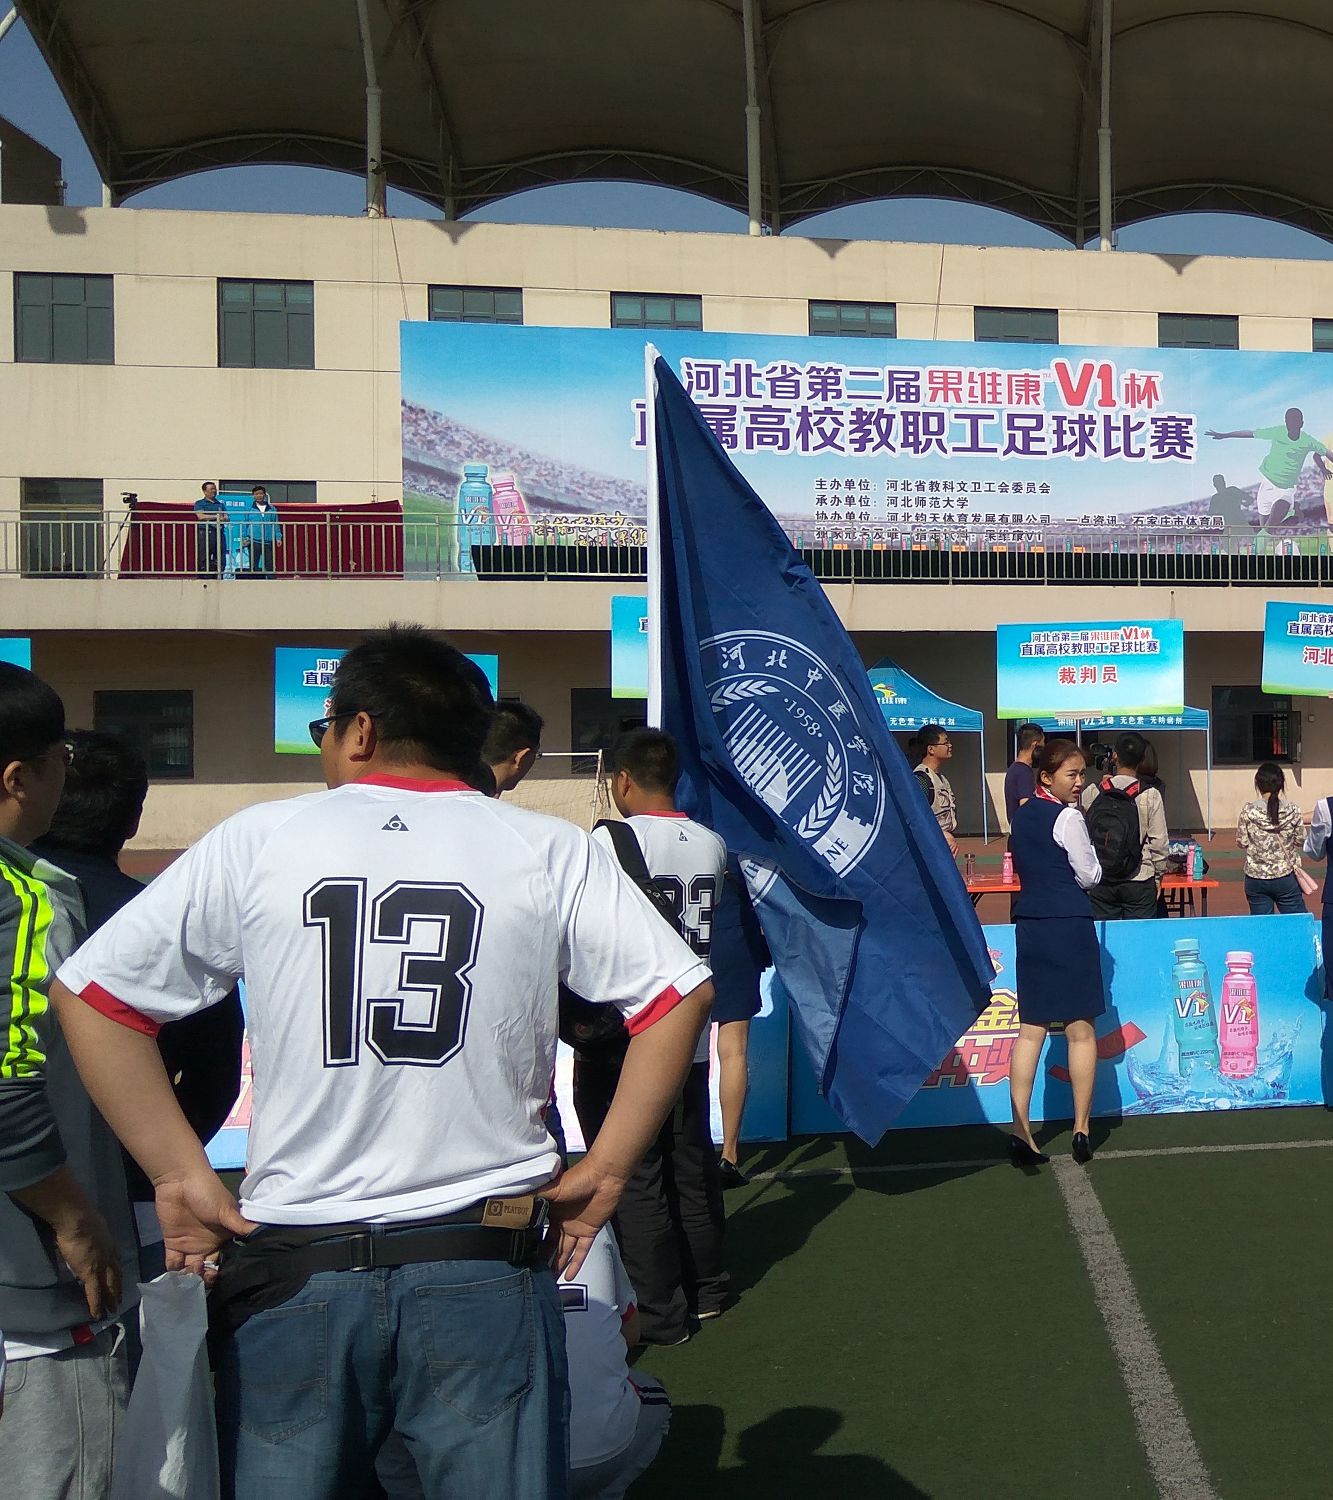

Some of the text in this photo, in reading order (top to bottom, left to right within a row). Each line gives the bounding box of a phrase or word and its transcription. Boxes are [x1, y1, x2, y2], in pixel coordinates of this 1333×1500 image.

[634, 404, 1195, 460] 属高校教职工足球比赛
[1021, 641, 1158, 656] 直属高校教职工足球比赛
[1059, 667, 1118, 684] 裁判员
[787, 700, 820, 736] 1958
[304, 877, 484, 1067] 13
[1175, 997, 1205, 1019] V1
[1223, 1003, 1251, 1025] V1
